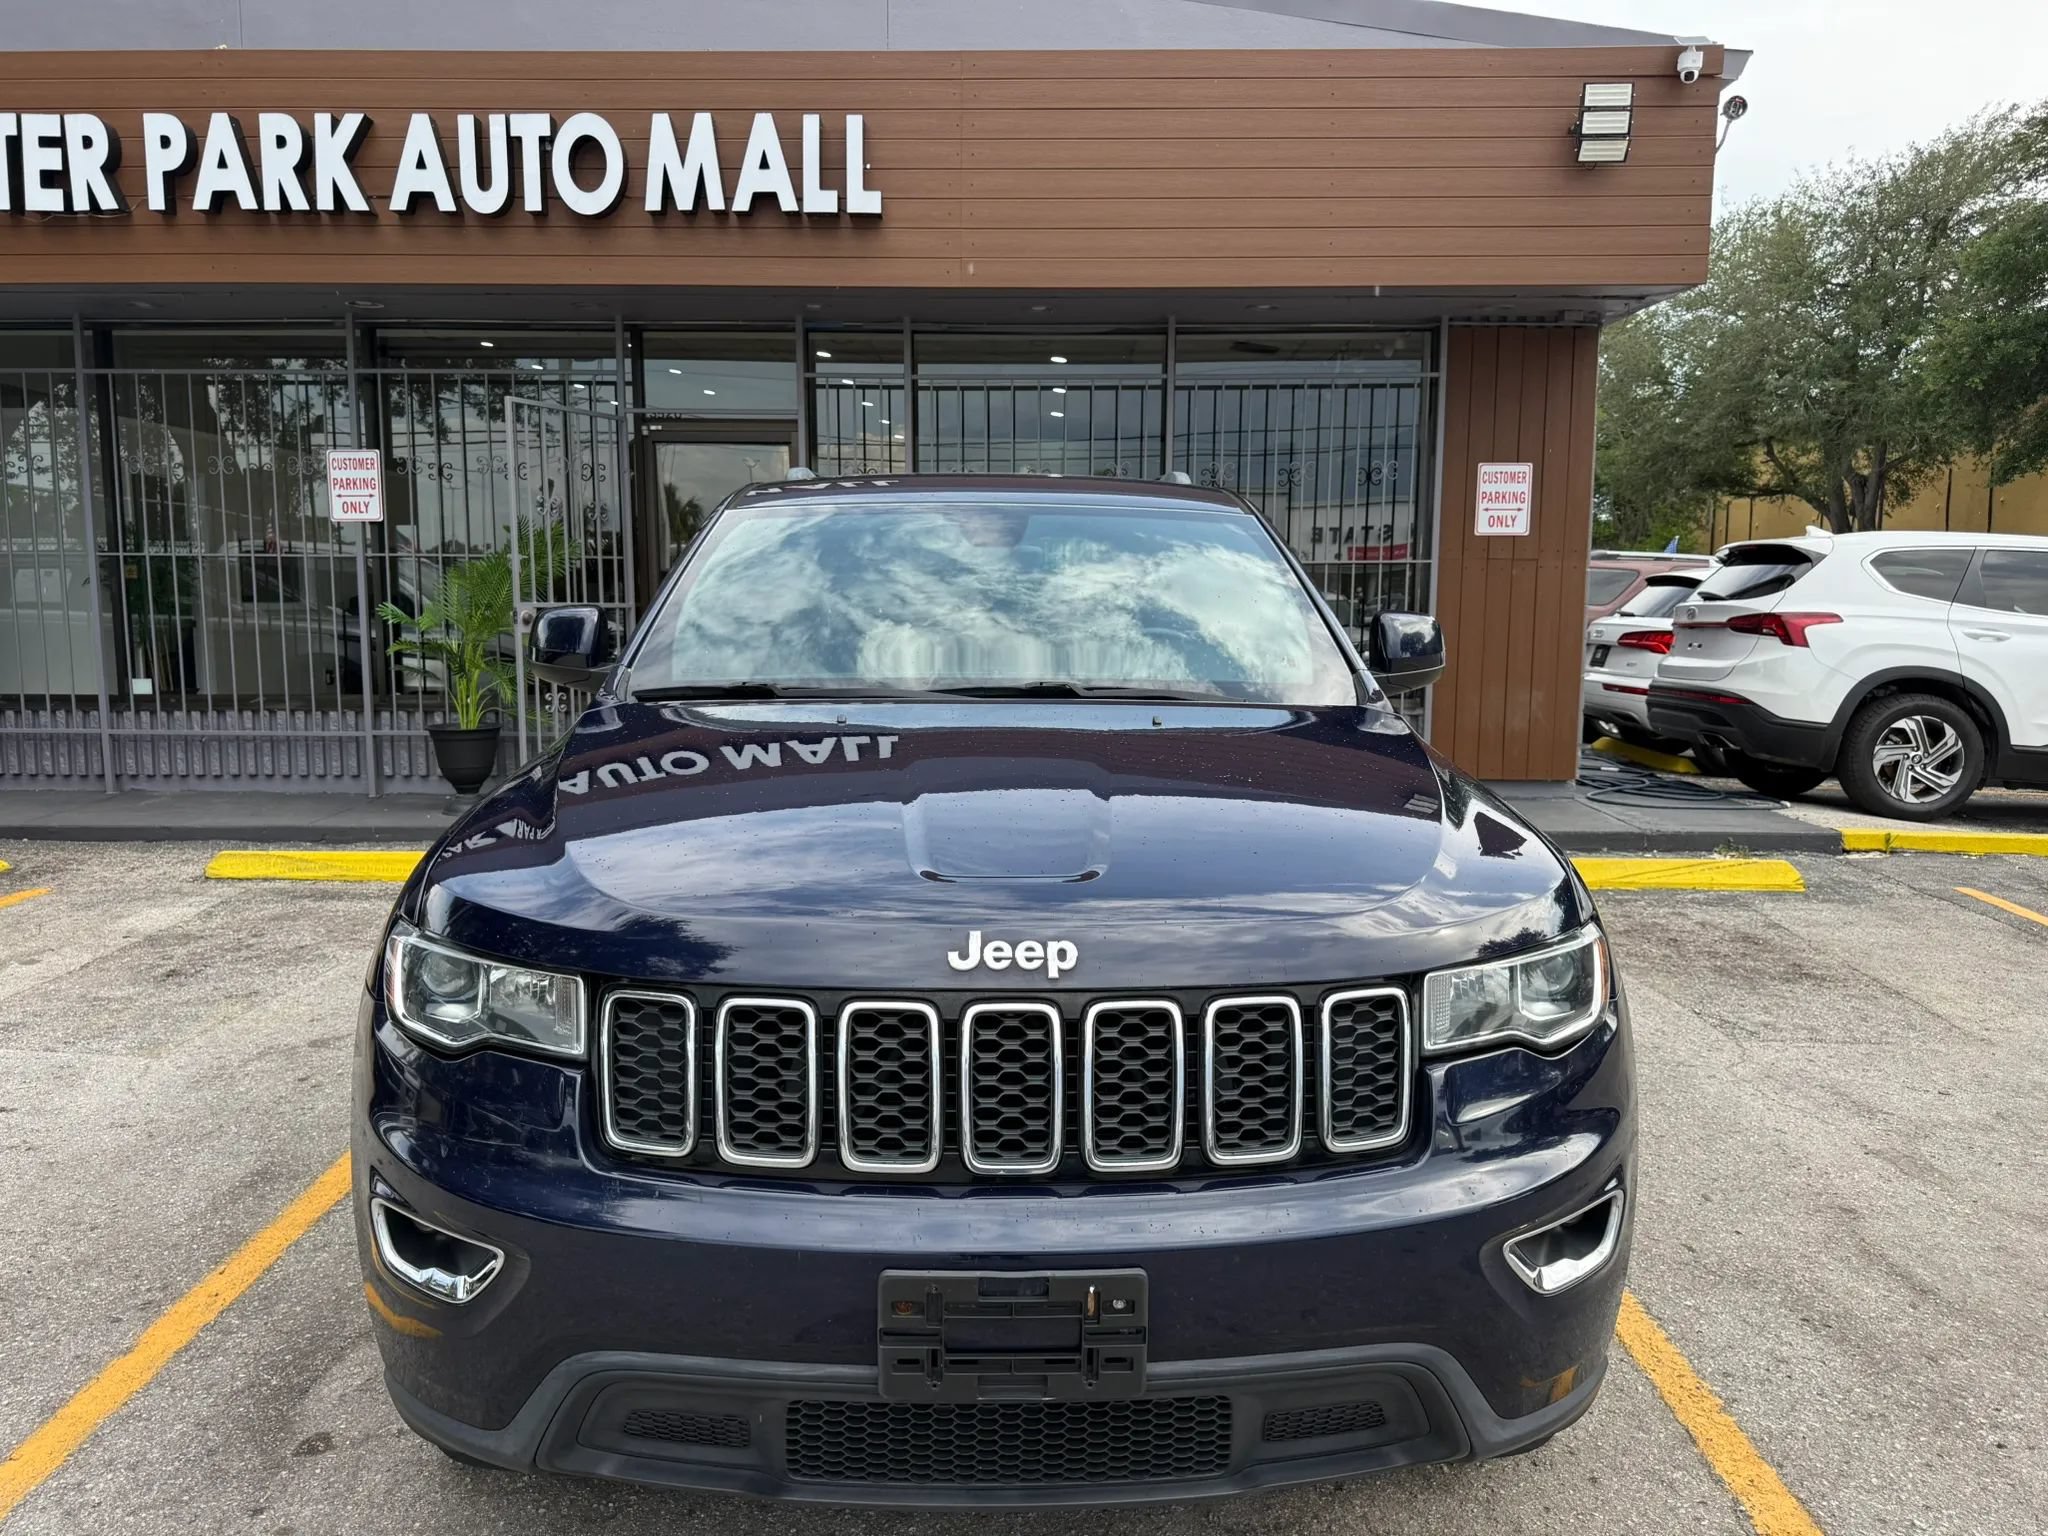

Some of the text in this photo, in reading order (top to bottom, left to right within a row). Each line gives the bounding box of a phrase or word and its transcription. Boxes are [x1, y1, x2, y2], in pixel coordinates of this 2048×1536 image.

[143, 113, 369, 210] PARK
[389, 113, 623, 214] AUTO
[645, 113, 881, 213] MALL
[331, 457, 376, 471] CUSTOMER
[333, 477, 377, 491] PARKING
[1482, 471, 1527, 484] CUSTOMER
[1481, 491, 1526, 505] PARKING
[342, 501, 370, 514] ONLY
[1488, 515, 1517, 528] ONLY
[948, 931, 1078, 977] Jeep
